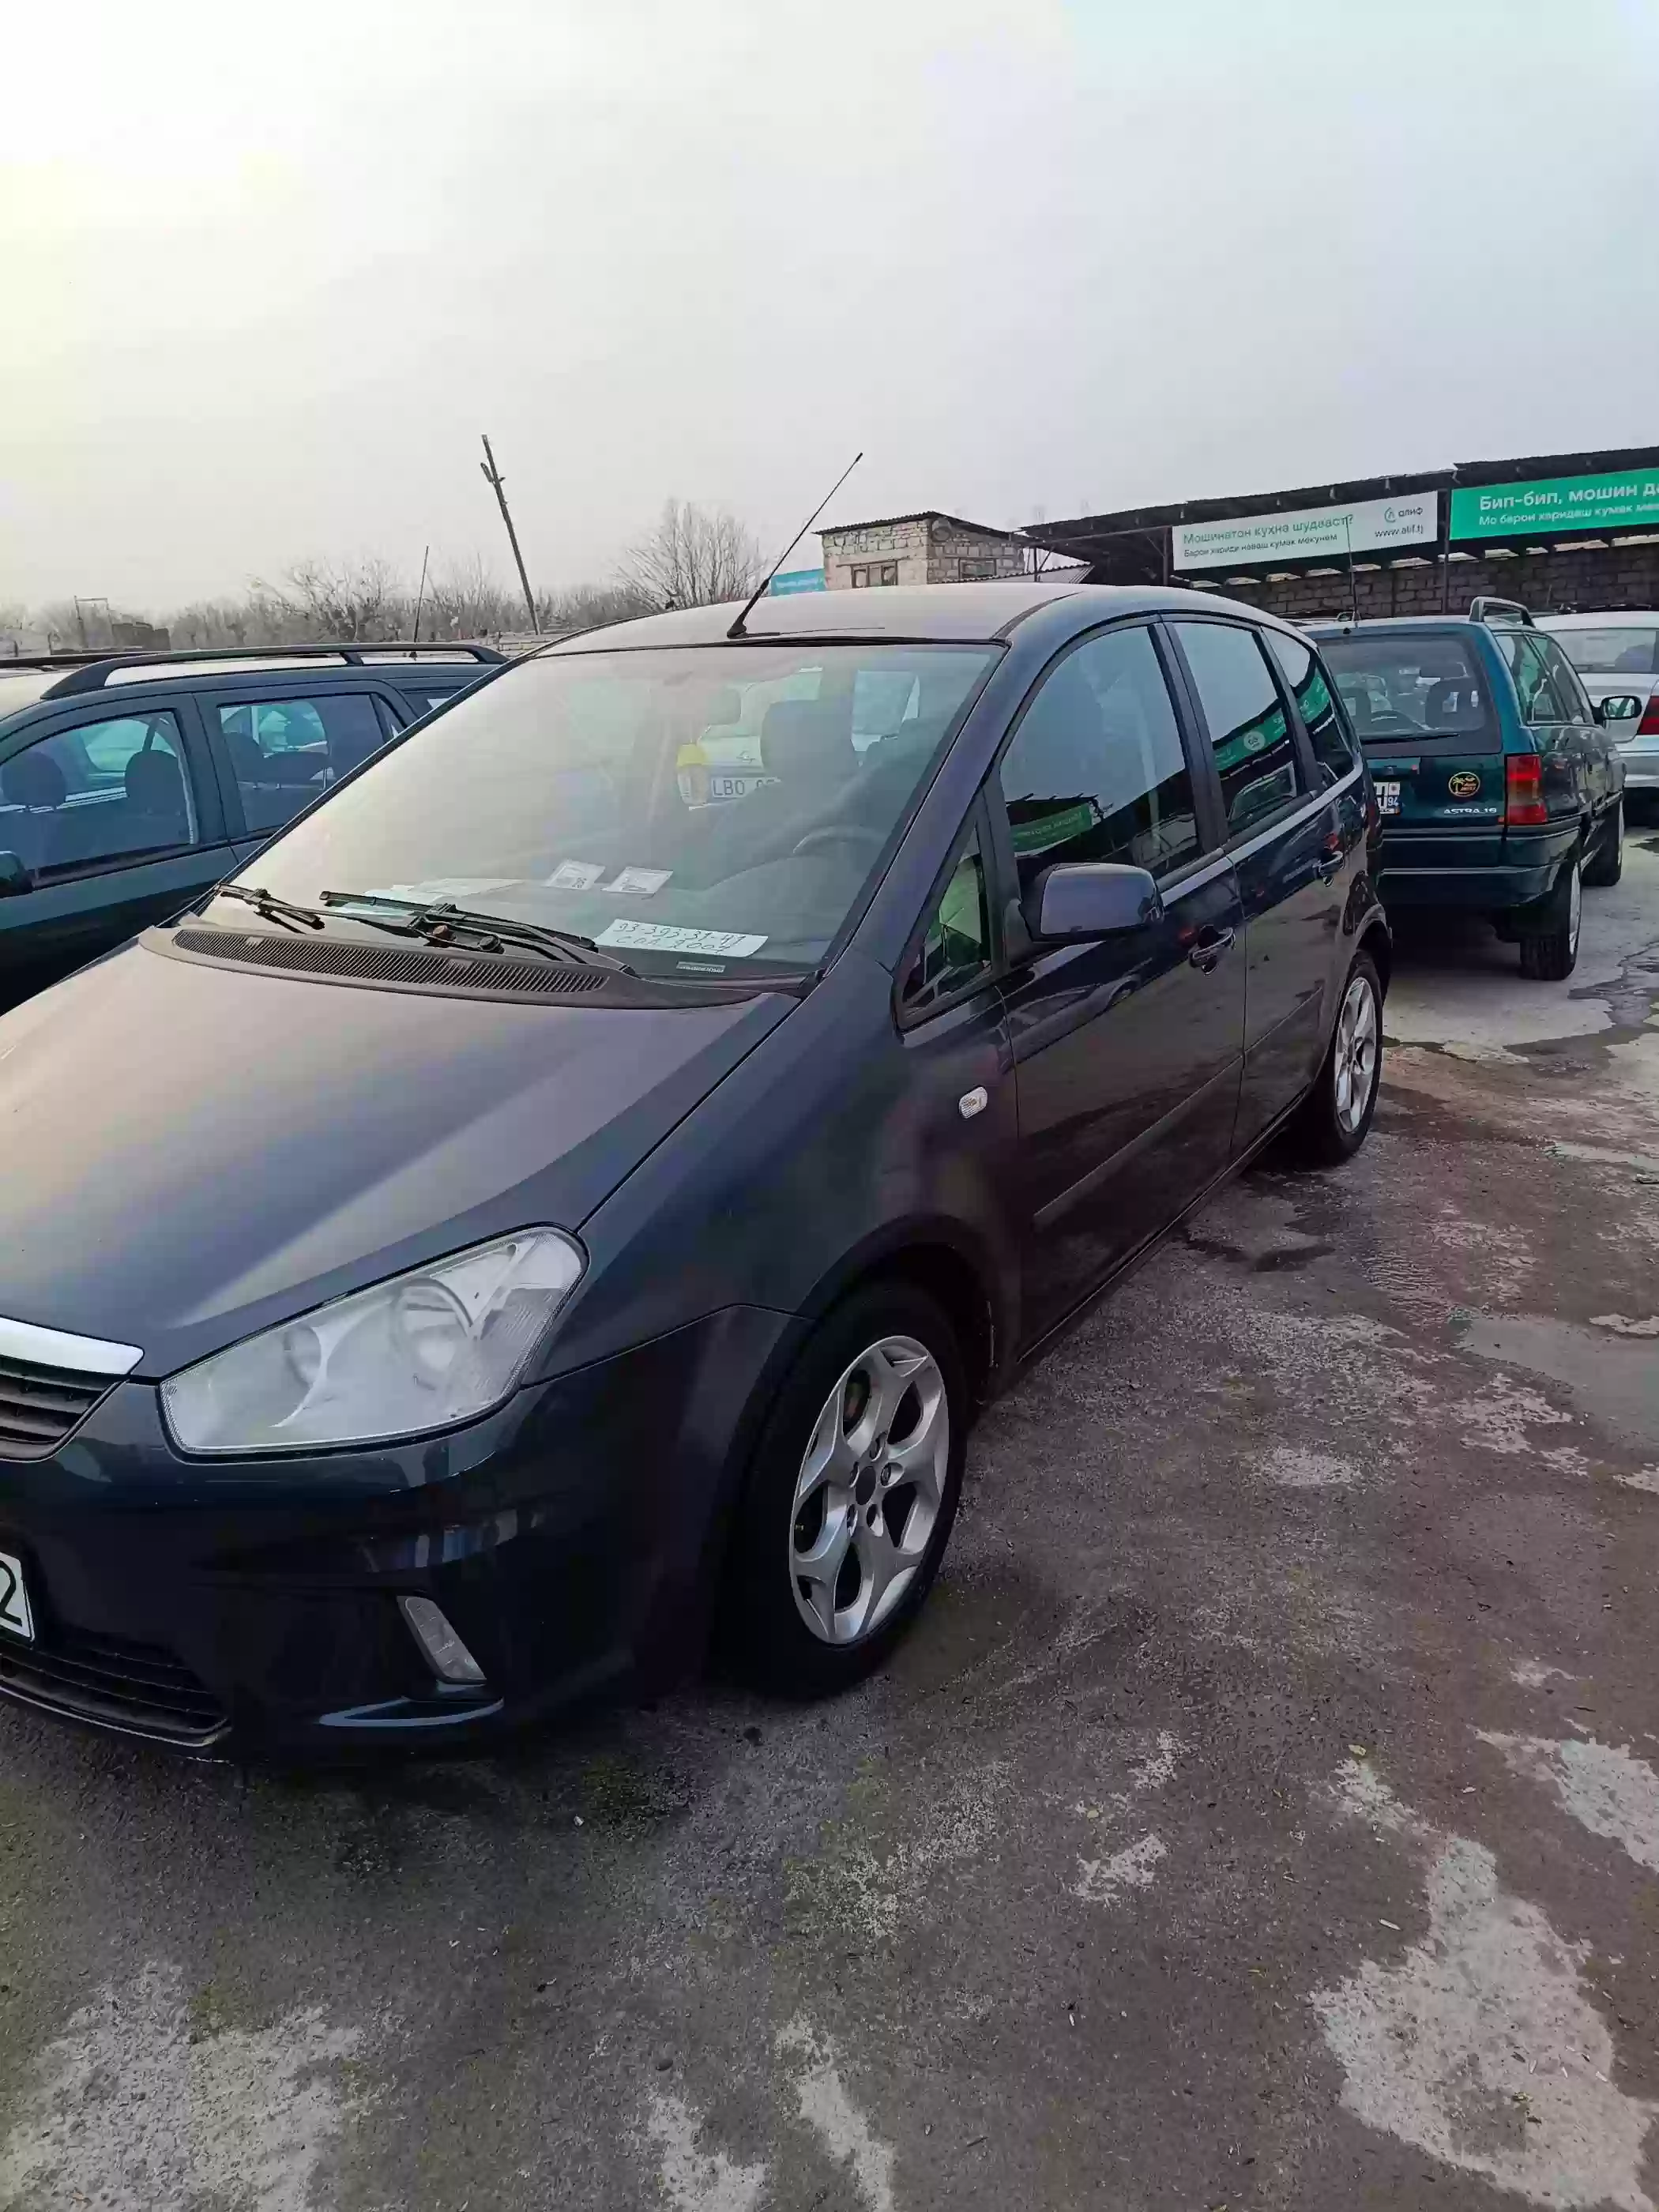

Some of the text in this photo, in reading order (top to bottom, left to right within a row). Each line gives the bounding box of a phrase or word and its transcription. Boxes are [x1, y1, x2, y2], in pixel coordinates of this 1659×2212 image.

[1480, 491, 1563, 510] Бип-бип,
[1569, 484, 1638, 502] мошин
[1398, 506, 1424, 517] алиф
[1479, 515, 1496, 525] Мо
[1183, 527, 1252, 545] Мошинатон
[1375, 524, 1424, 538] www.alif.tj
